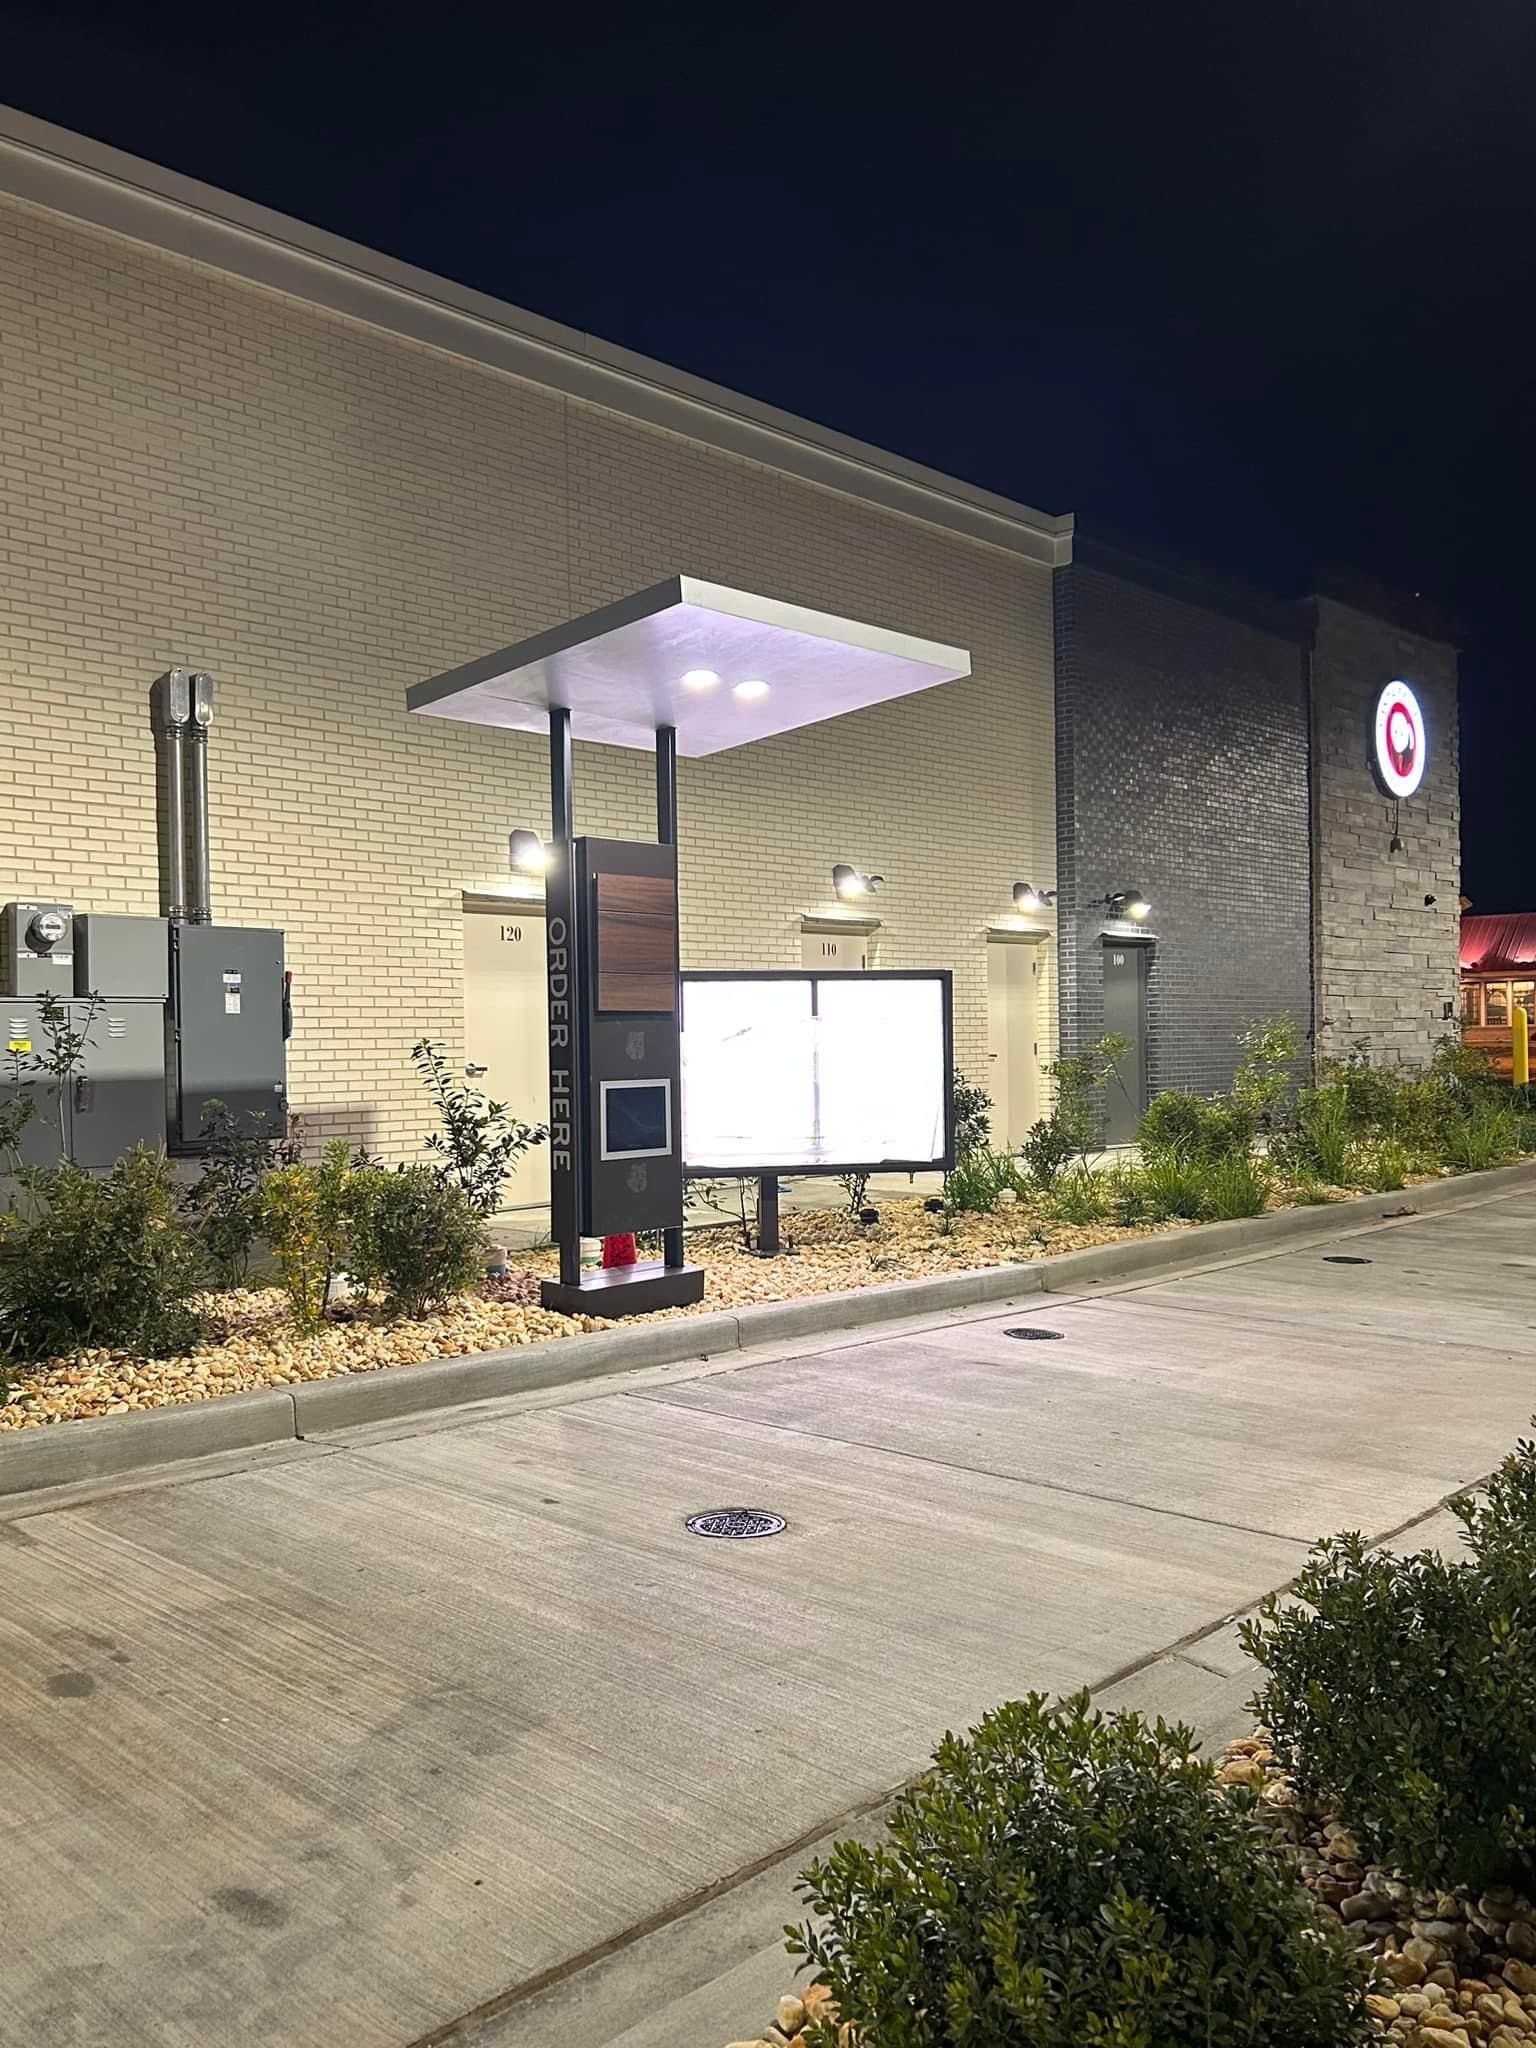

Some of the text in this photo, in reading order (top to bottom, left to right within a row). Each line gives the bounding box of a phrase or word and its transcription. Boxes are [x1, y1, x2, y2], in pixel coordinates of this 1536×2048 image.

[501, 925, 522, 942] 120
[822, 942, 837, 957] 110
[1113, 953, 1125, 966] 100
[549, 917, 571, 1172] ORDER HERE
